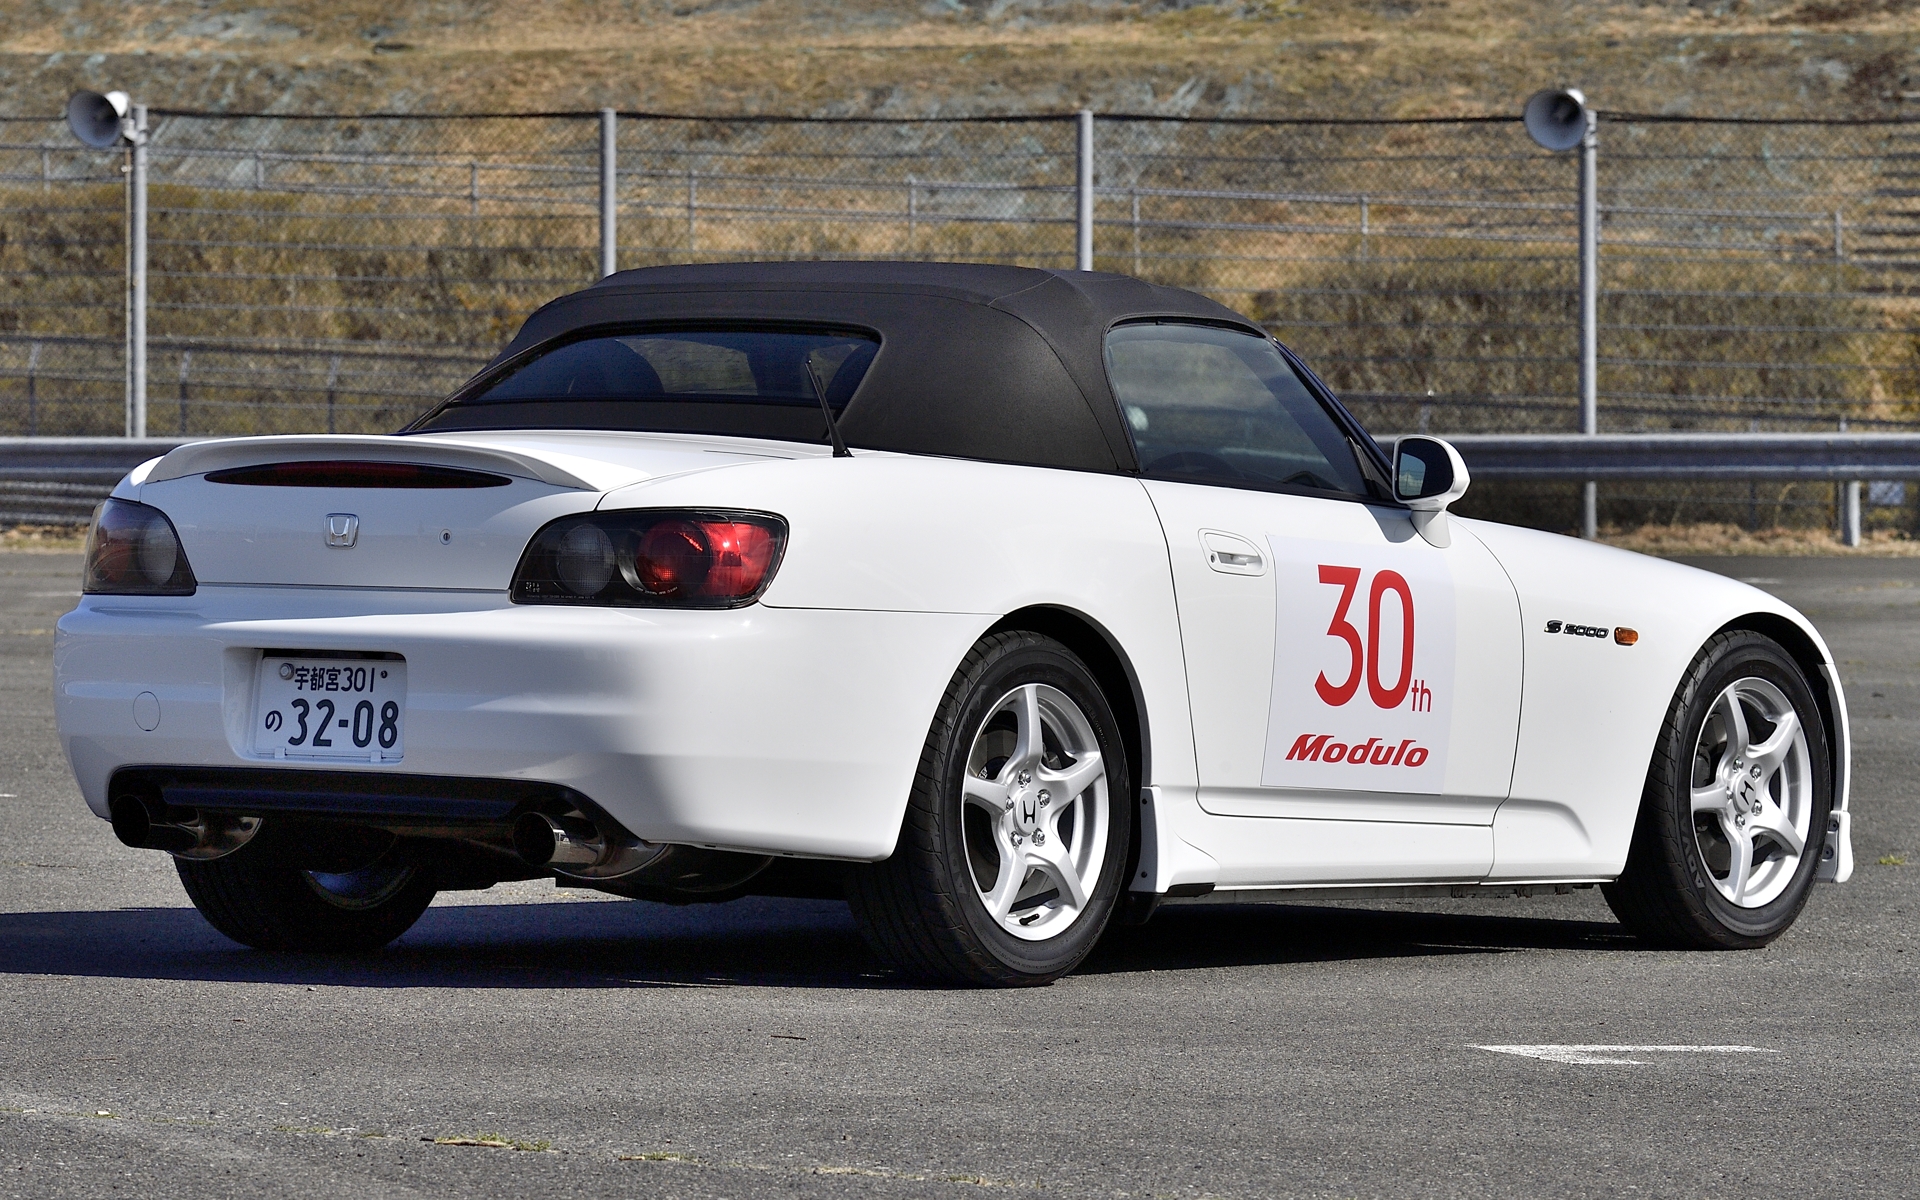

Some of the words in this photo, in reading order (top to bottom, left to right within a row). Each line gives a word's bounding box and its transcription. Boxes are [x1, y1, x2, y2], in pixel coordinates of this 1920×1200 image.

[264, 710, 283, 732] の
[287, 698, 399, 749] 32-08
[1285, 733, 1429, 768] Modulo
